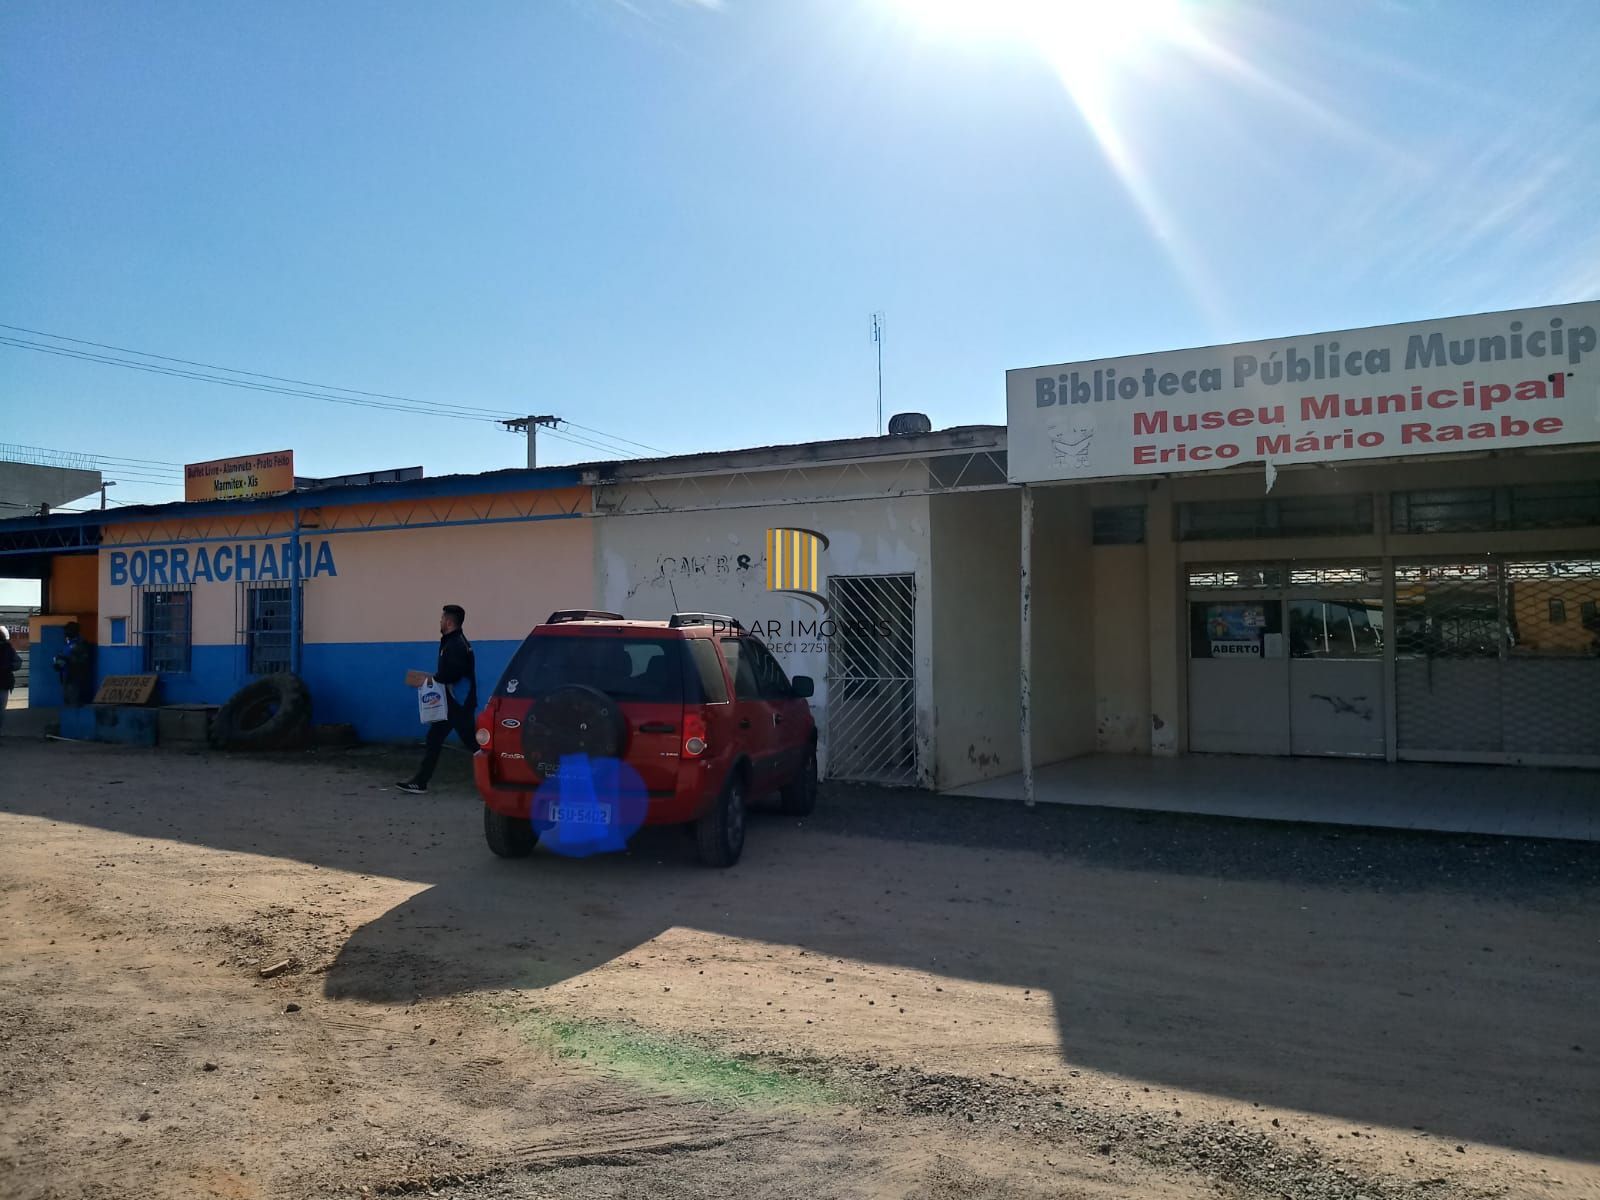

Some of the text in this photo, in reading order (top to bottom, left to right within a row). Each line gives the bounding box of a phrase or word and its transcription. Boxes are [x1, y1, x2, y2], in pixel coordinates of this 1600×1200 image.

[1036, 317, 1597, 408] Biblioteca Pública Municip
[1133, 372, 1565, 436] Museu Municipal
[1133, 415, 1564, 464] Erico Mário Raabe
[214, 475, 258, 491] Marmitex Xis
[110, 541, 338, 587] BORRACHARIA
[1213, 644, 1259, 653] ABERTO
[101, 688, 142, 702] LONAS
